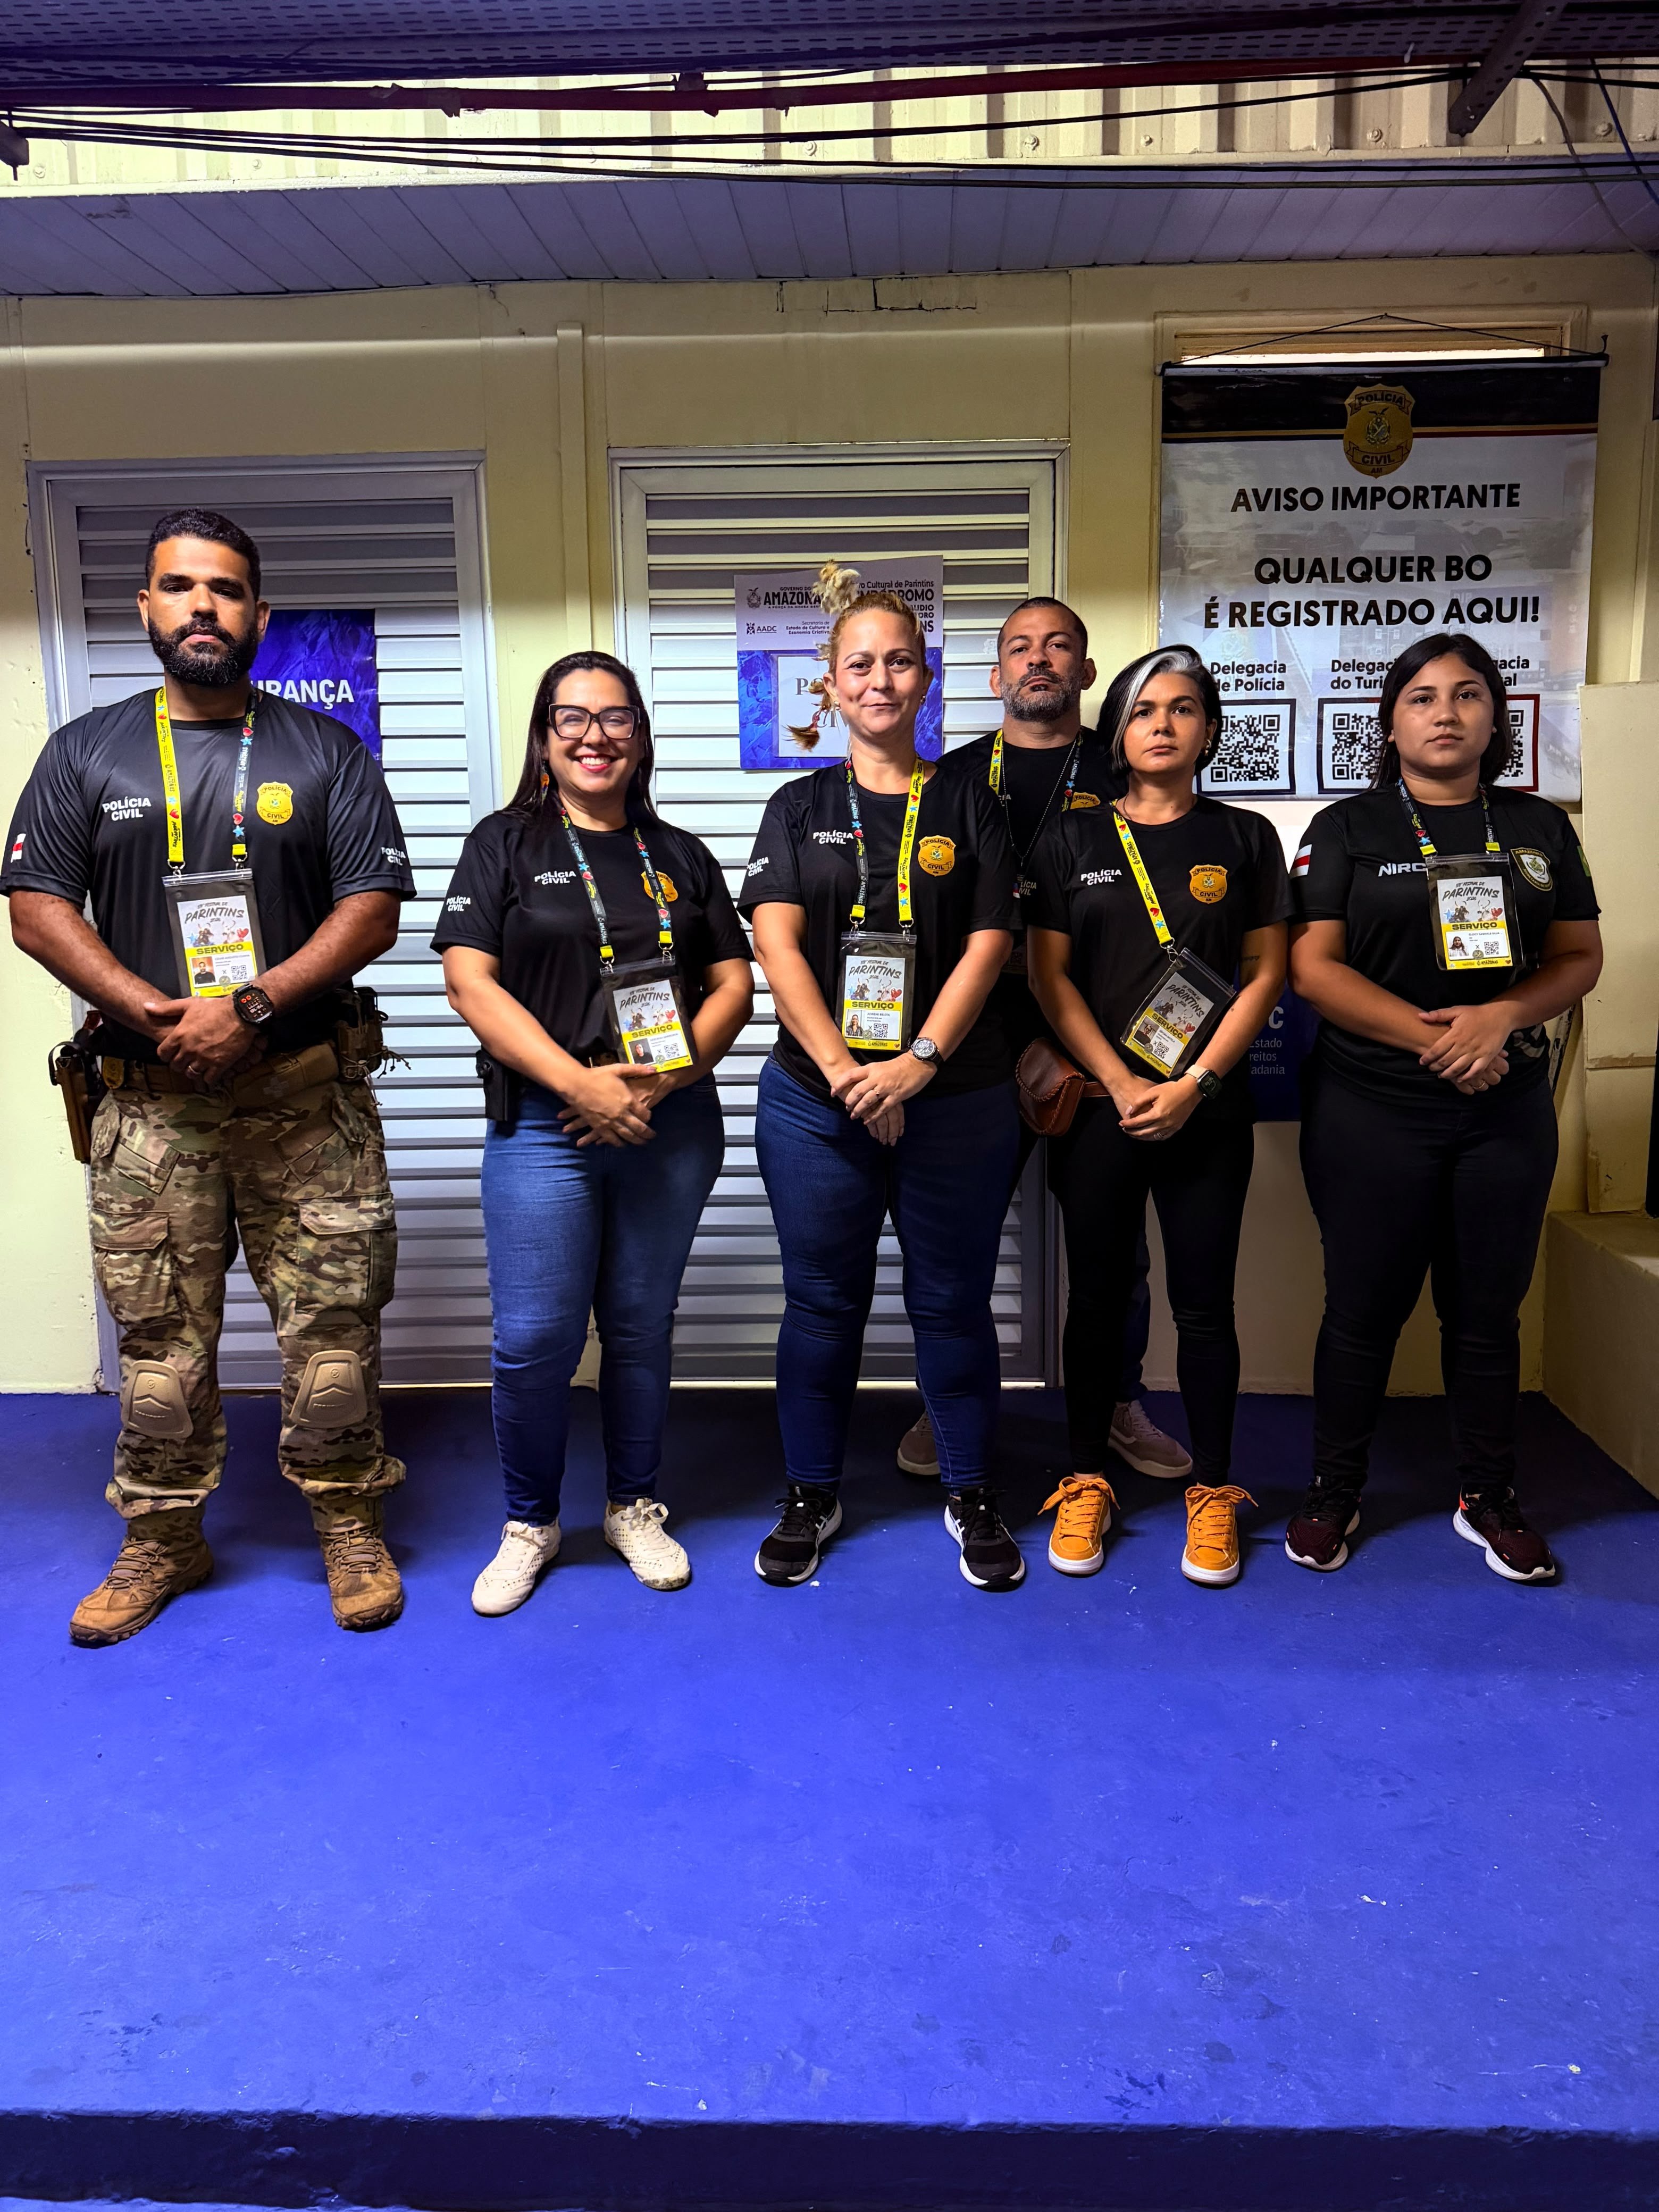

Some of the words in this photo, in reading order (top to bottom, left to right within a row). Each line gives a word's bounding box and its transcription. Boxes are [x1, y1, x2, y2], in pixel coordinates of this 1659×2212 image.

[1362, 454, 1395, 465] CIVIL
[1230, 487, 1324, 512] AVISO
[1331, 483, 1521, 510] IMPORTANTE
[1254, 556, 1437, 584] QUALQUER
[1445, 554, 1492, 582] BO
[904, 579, 934, 588] Parintins
[1204, 596, 1220, 629] É
[1229, 598, 1435, 628] REGISTRADO
[1442, 596, 1540, 625] AQUI!
[1211, 660, 1286, 677] Delegacia
[1331, 659, 1394, 675] Delegac
[1235, 677, 1285, 691] Polícia
[1330, 676, 1352, 690] do
[1355, 676, 1383, 689] Turi
[102, 796, 152, 813] POLÍCIA
[111, 808, 144, 821] CIVIL
[813, 830, 854, 840] POLÍCIA
[534, 870, 577, 882] POLÍCIA
[1080, 869, 1122, 881] POLÍCIA
[1087, 876, 1115, 885] CIVIL
[1020, 879, 1037, 889] LÍCIA
[446, 895, 471, 905] POLÍCIA
[1442, 887, 1499, 901] PARINTINS
[185, 907, 245, 924] PARINTINS
[196, 944, 244, 955] SERVIÇO
[849, 965, 902, 979] PARINTINS
[619, 992, 670, 1010] PARINTINS
[852, 1001, 894, 1010] SERVIÇO
[1165, 984, 1205, 1018] PARINTINS
[632, 1024, 673, 1038] SERVIÇO
[1152, 1013, 1183, 1039] SERVIÇO
[1250, 1037, 1282, 1048] stado
[1250, 1051, 1277, 1061] reitos
[1250, 1064, 1285, 1075] adania
